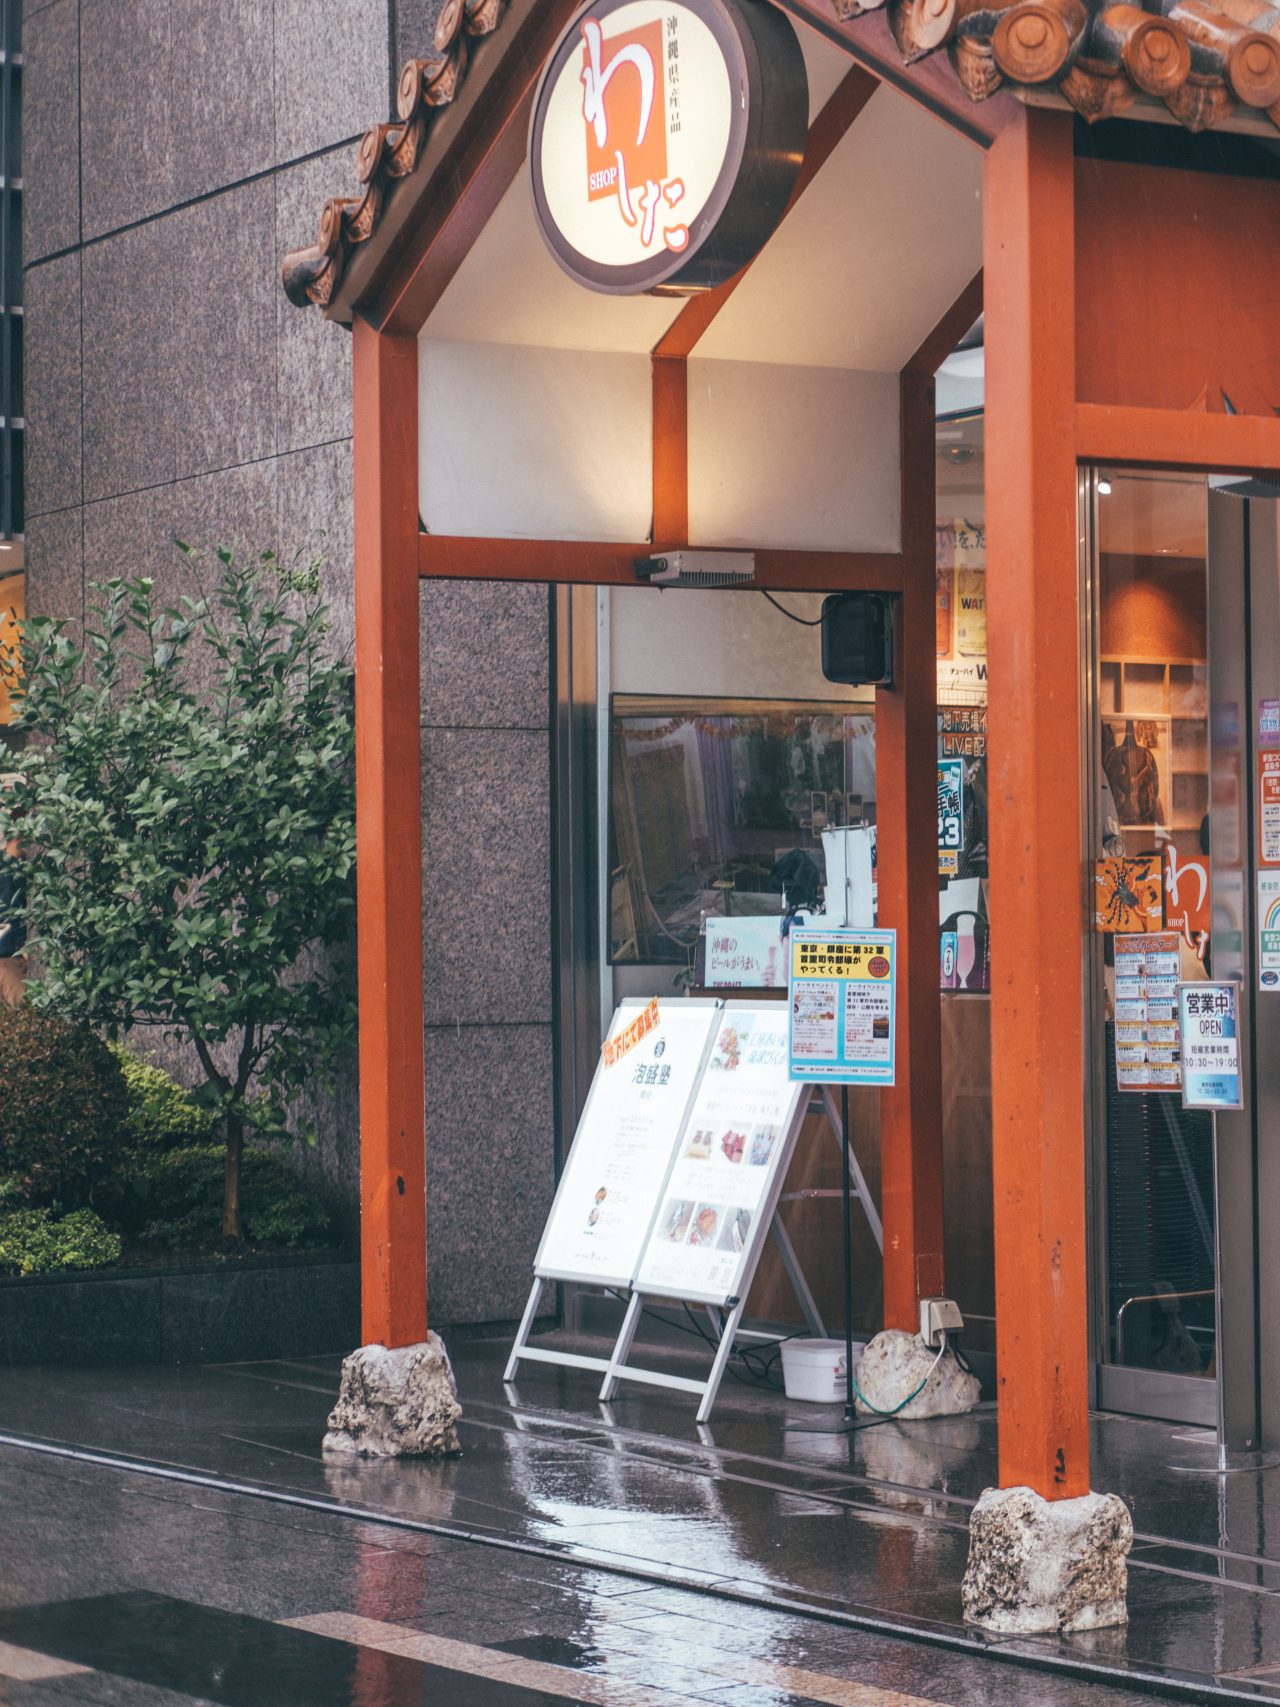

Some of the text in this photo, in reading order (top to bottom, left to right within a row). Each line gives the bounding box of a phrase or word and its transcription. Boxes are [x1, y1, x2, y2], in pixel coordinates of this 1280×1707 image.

[590, 166, 617, 190] SHOP
[1168, 918, 1184, 928] SHOP
[712, 938, 738, 954] 沖縄の
[1186, 993, 1229, 1015] 営業中
[1199, 1019, 1222, 1035] OPEN
